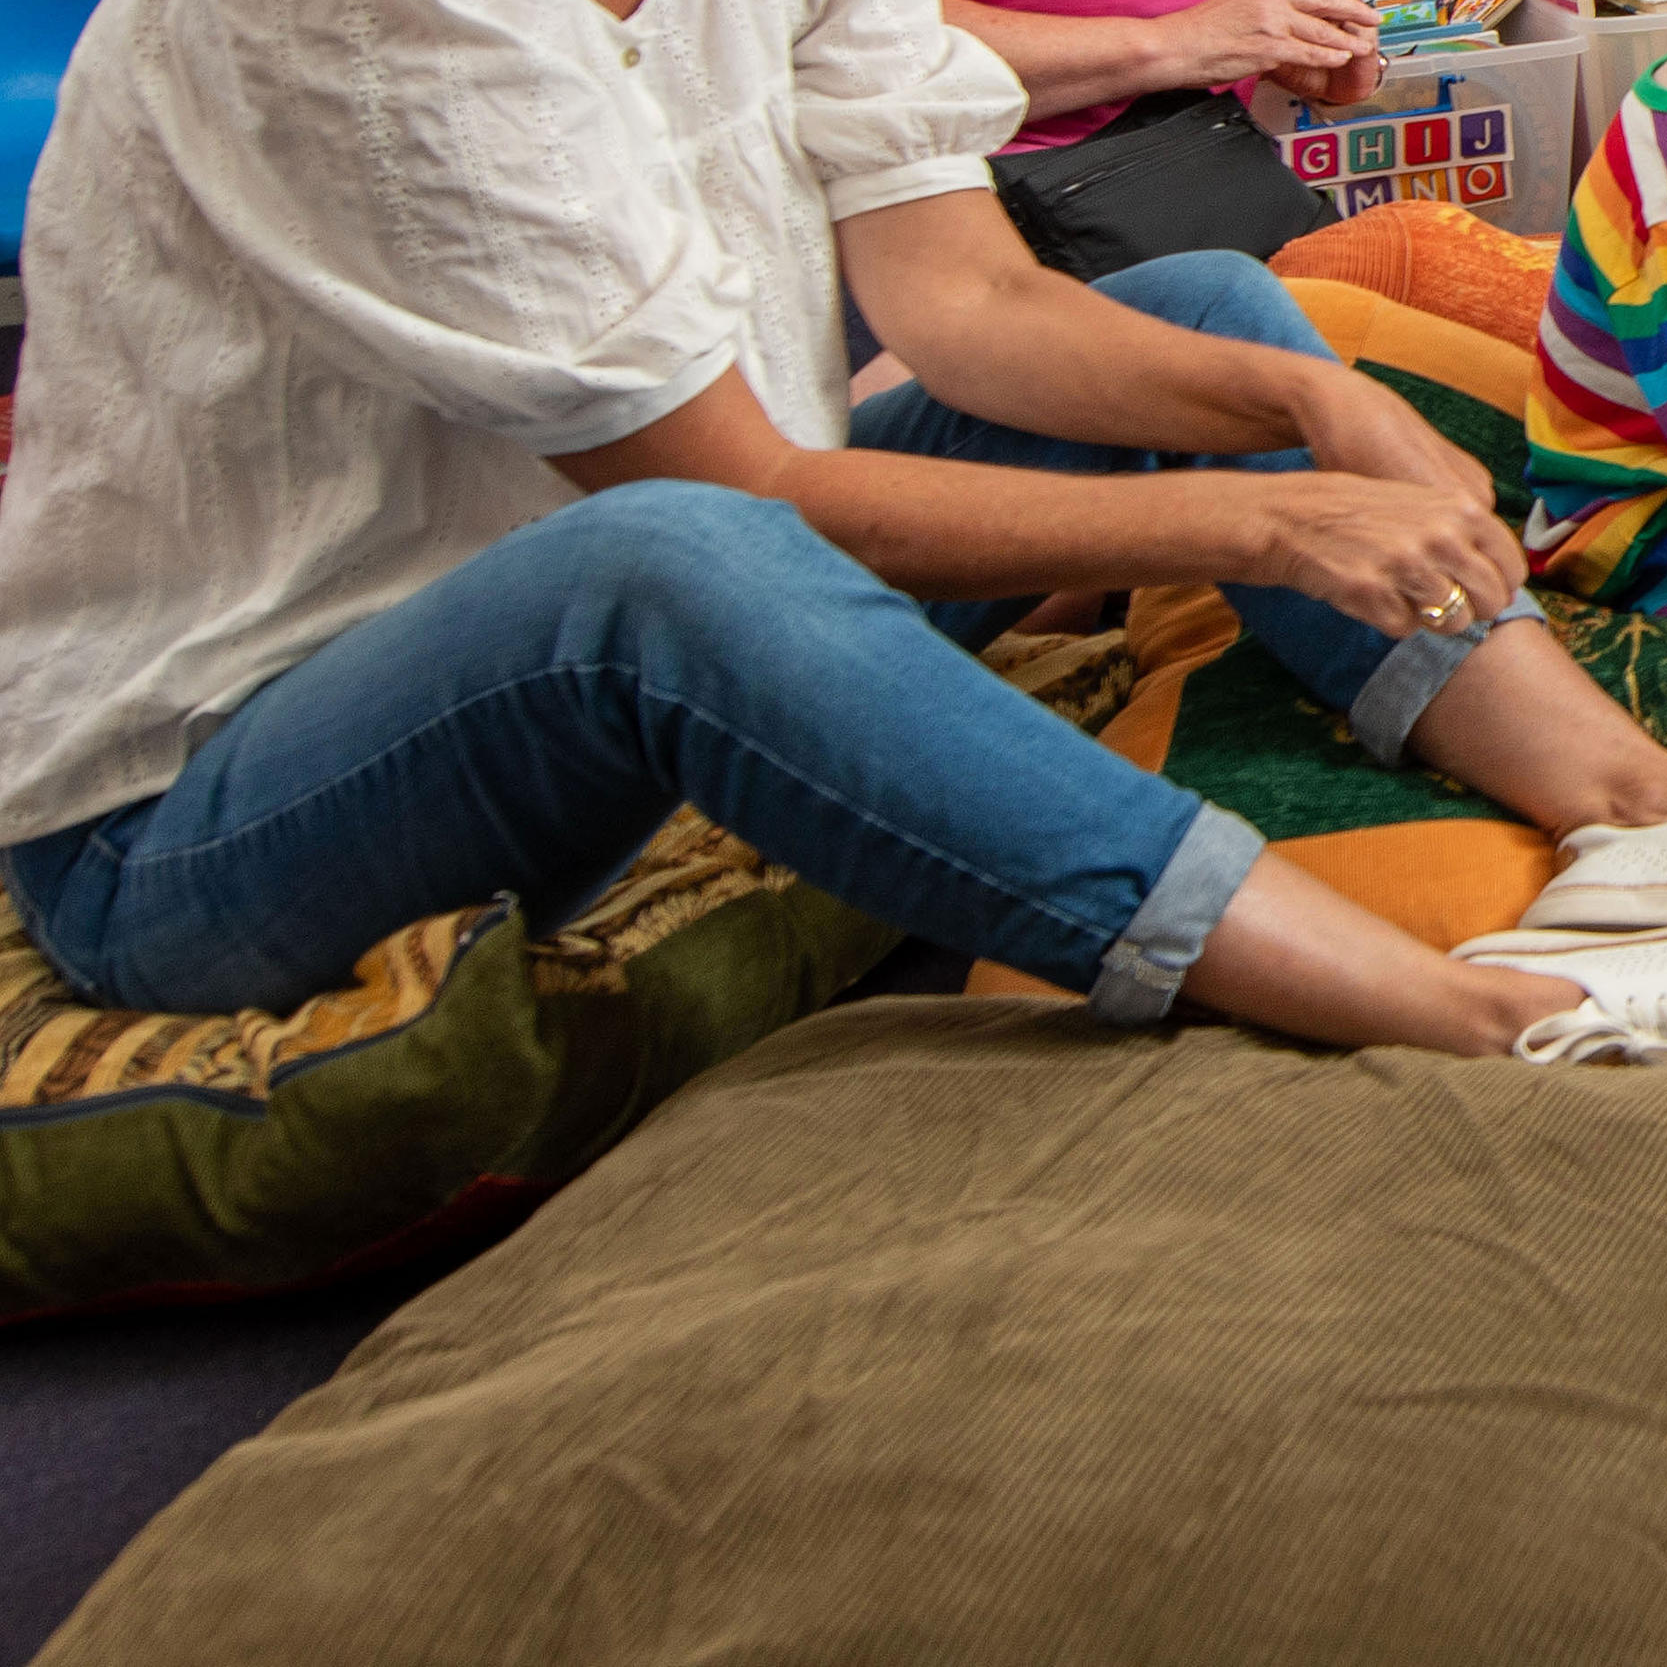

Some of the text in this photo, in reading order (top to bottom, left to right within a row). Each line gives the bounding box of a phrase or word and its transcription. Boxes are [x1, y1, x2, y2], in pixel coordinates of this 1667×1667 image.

[1301, 142, 1331, 174] G
[1359, 133, 1385, 166] H
[1474, 118, 1491, 151] J
[1467, 164, 1497, 195] O
